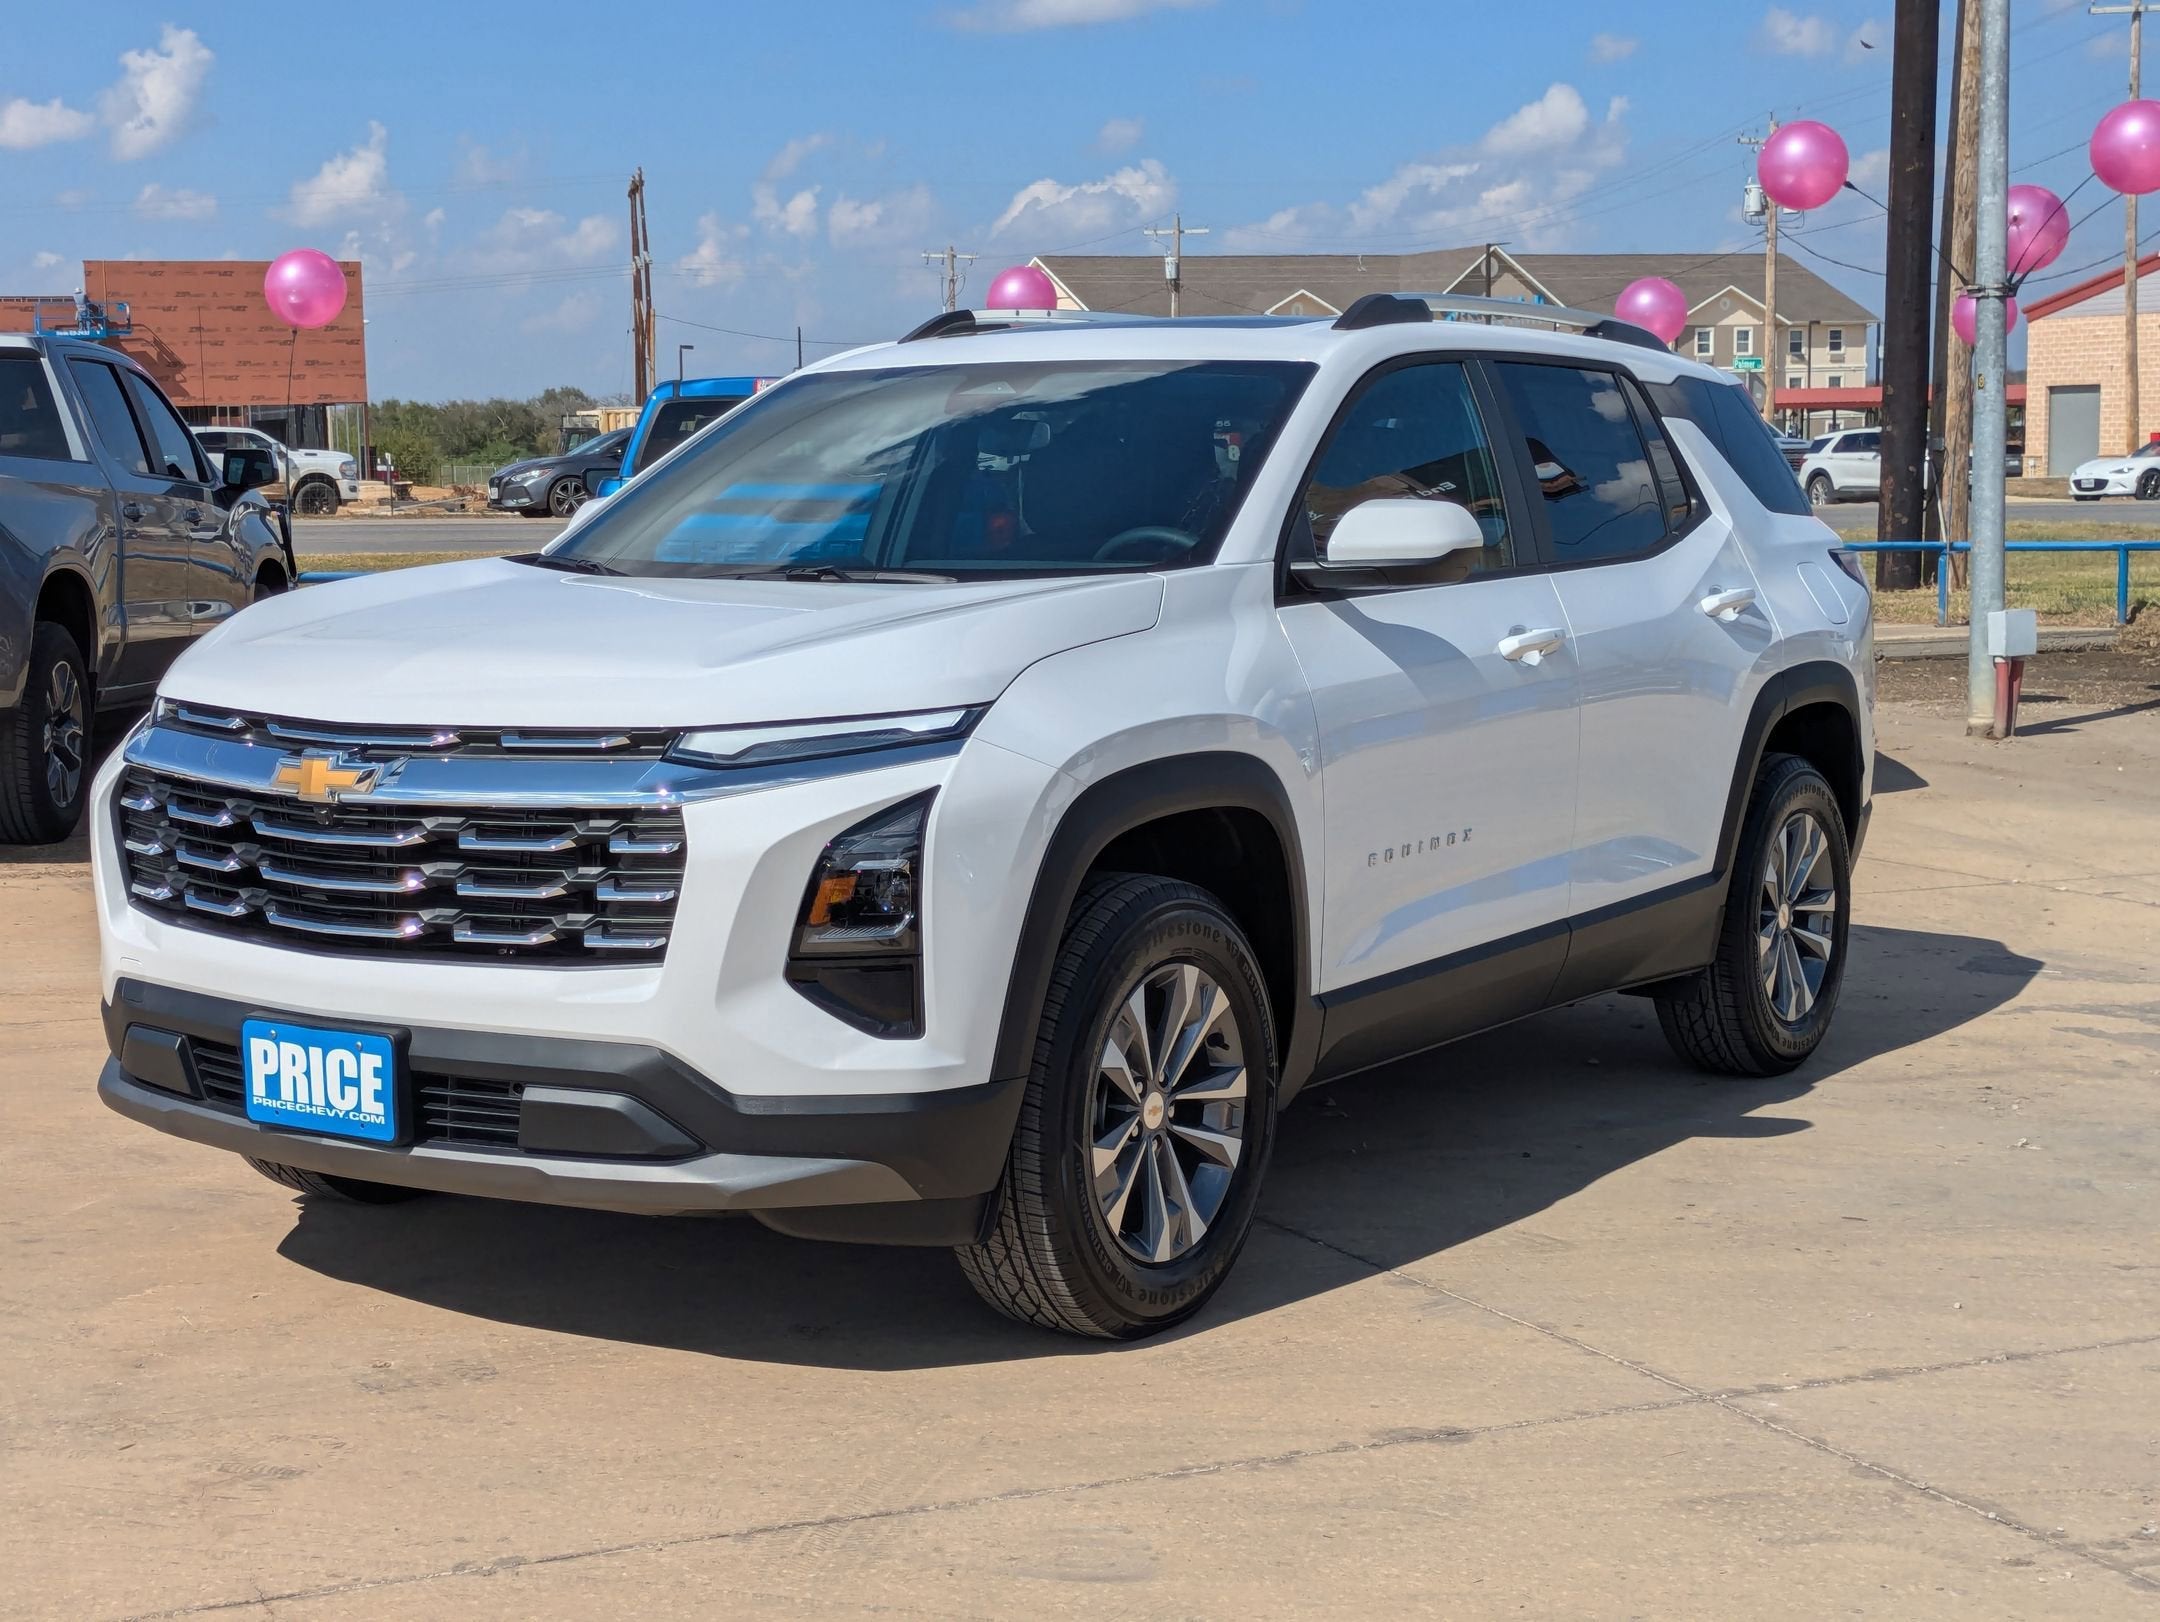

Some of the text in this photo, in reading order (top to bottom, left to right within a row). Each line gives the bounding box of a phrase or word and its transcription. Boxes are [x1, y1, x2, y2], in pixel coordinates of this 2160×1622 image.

[1735, 360, 1756, 369] Palmer
[1368, 828, 1472, 867] EQUINOX
[250, 1037, 384, 1115] PRICE
[252, 1096, 385, 1125] PRICECHEVY.COM
